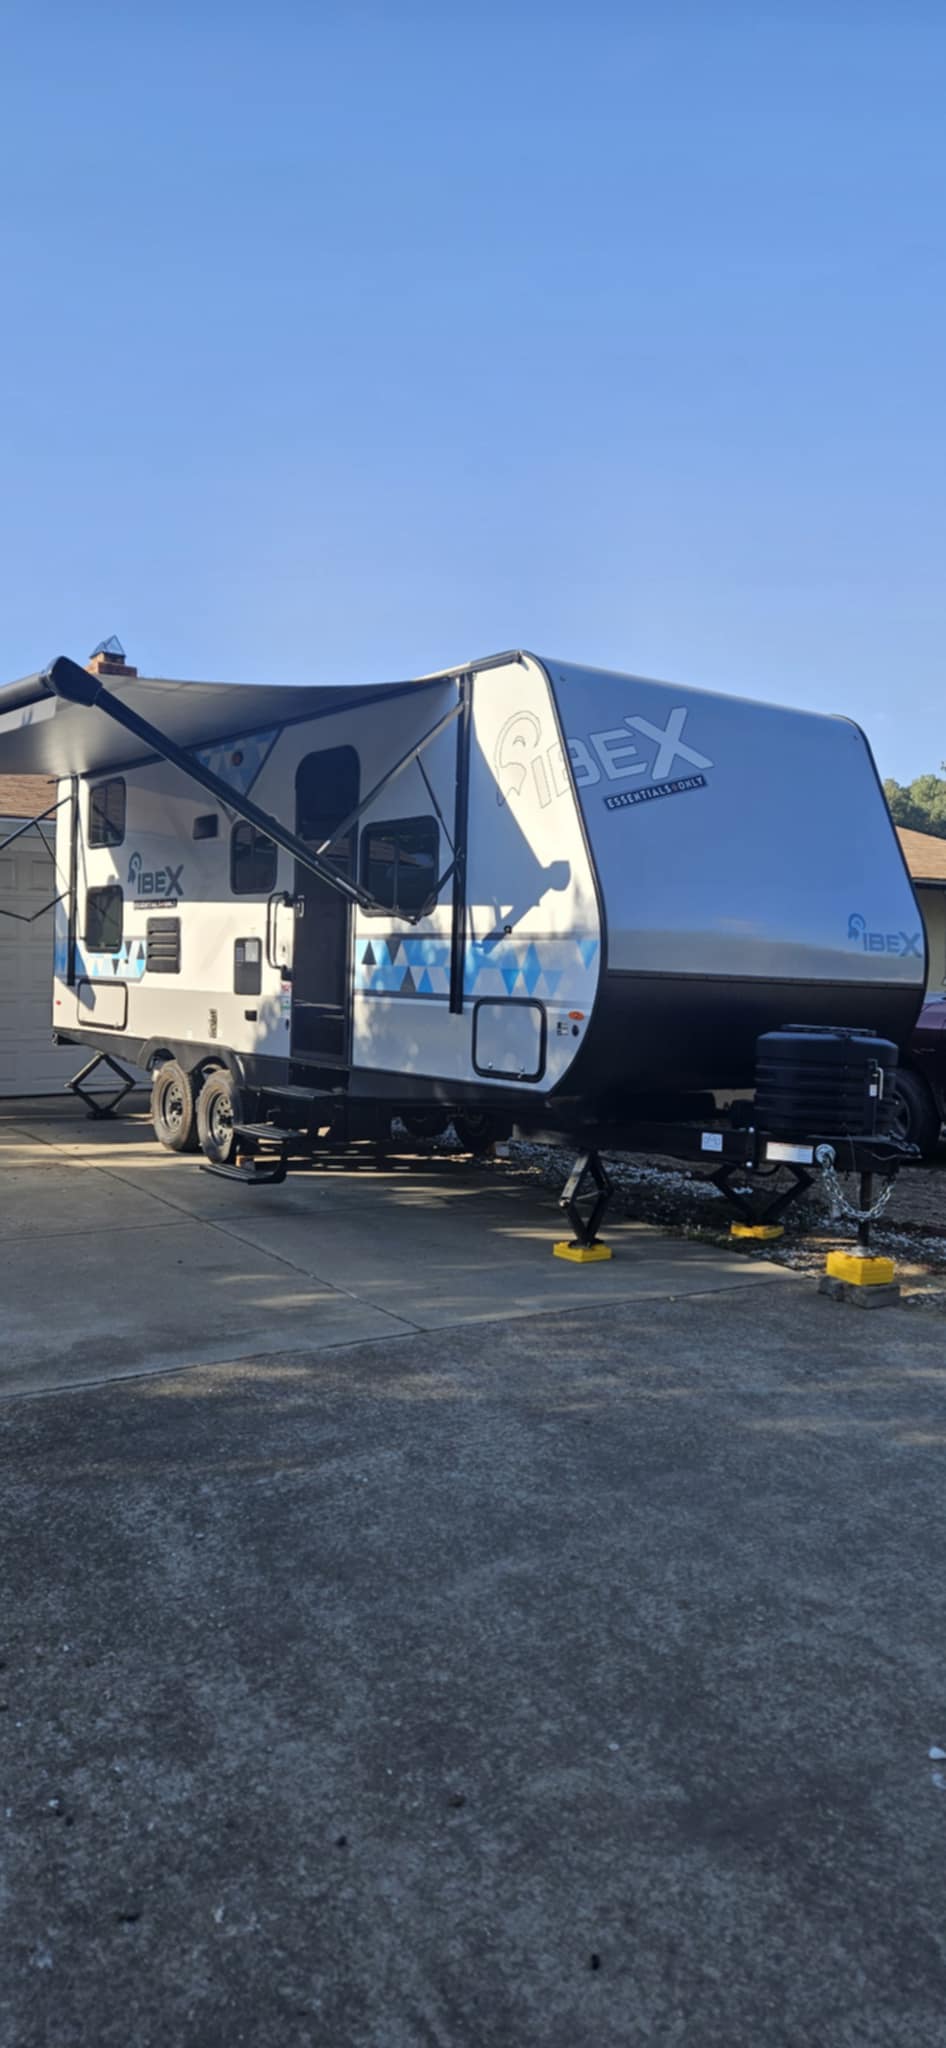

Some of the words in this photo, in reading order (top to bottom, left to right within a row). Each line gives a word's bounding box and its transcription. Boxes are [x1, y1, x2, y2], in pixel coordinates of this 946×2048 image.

[531, 706, 715, 809] IBEX
[607, 785, 672, 809] ESSENTIALS
[677, 776, 704, 791] ONLY
[137, 864, 184, 896] IBEX
[863, 930, 922, 958] IBEX
